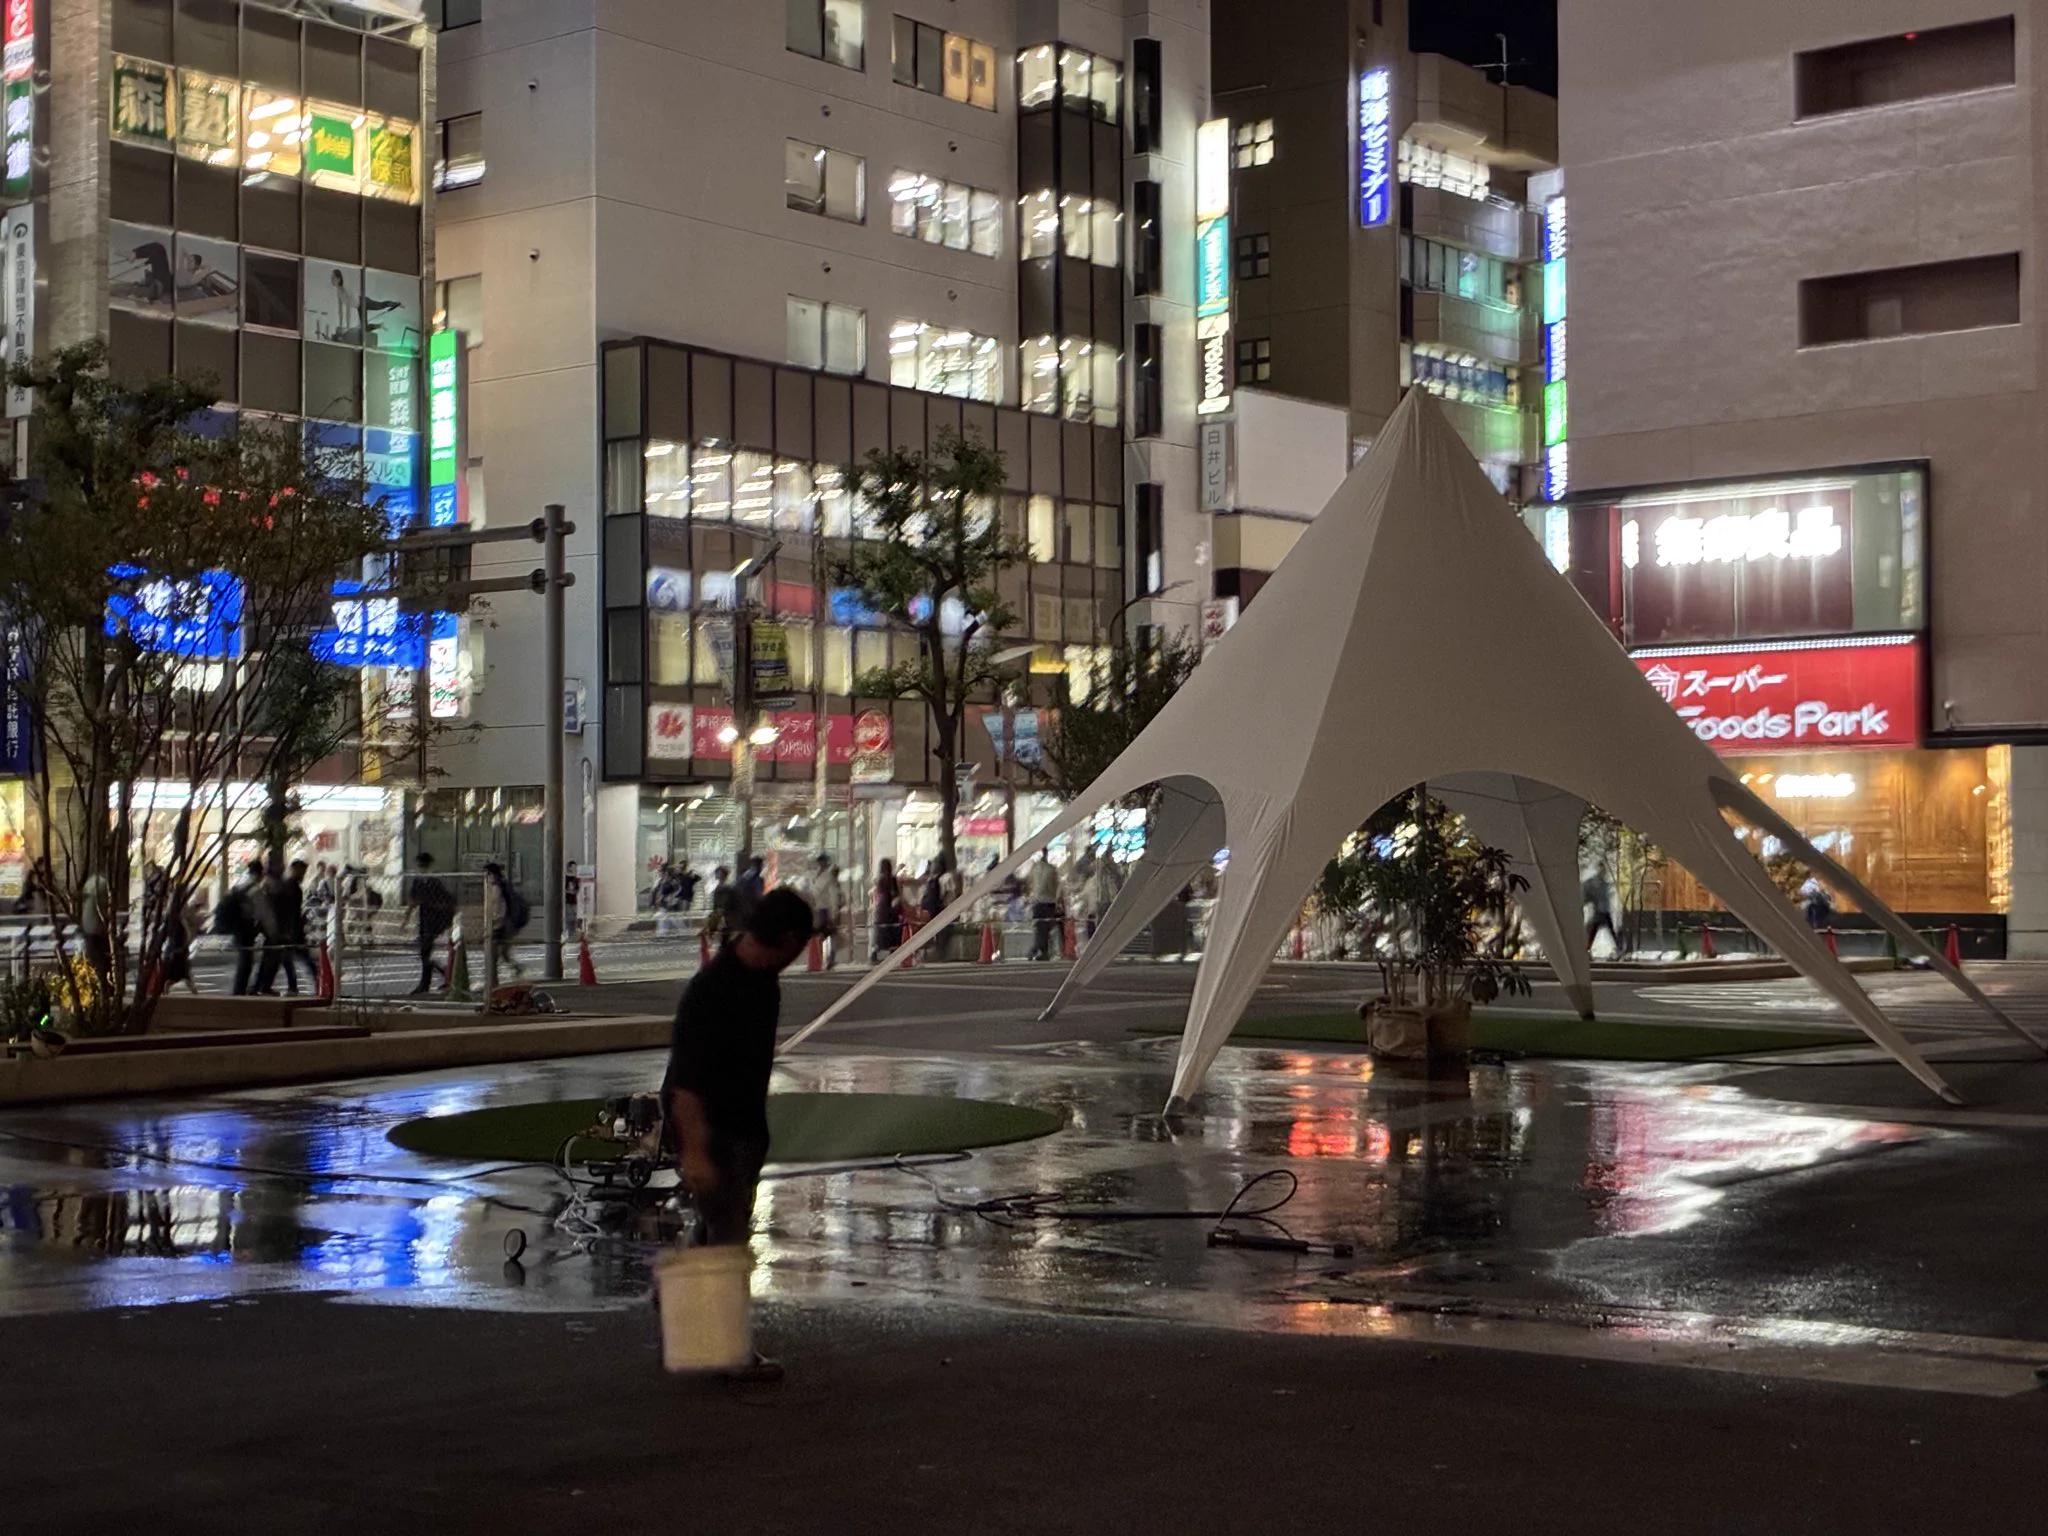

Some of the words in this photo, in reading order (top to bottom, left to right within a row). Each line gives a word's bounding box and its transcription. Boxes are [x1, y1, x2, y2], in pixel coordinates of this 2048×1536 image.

[1682, 664, 1788, 697] スーパー
[1795, 701, 1889, 737] Park
